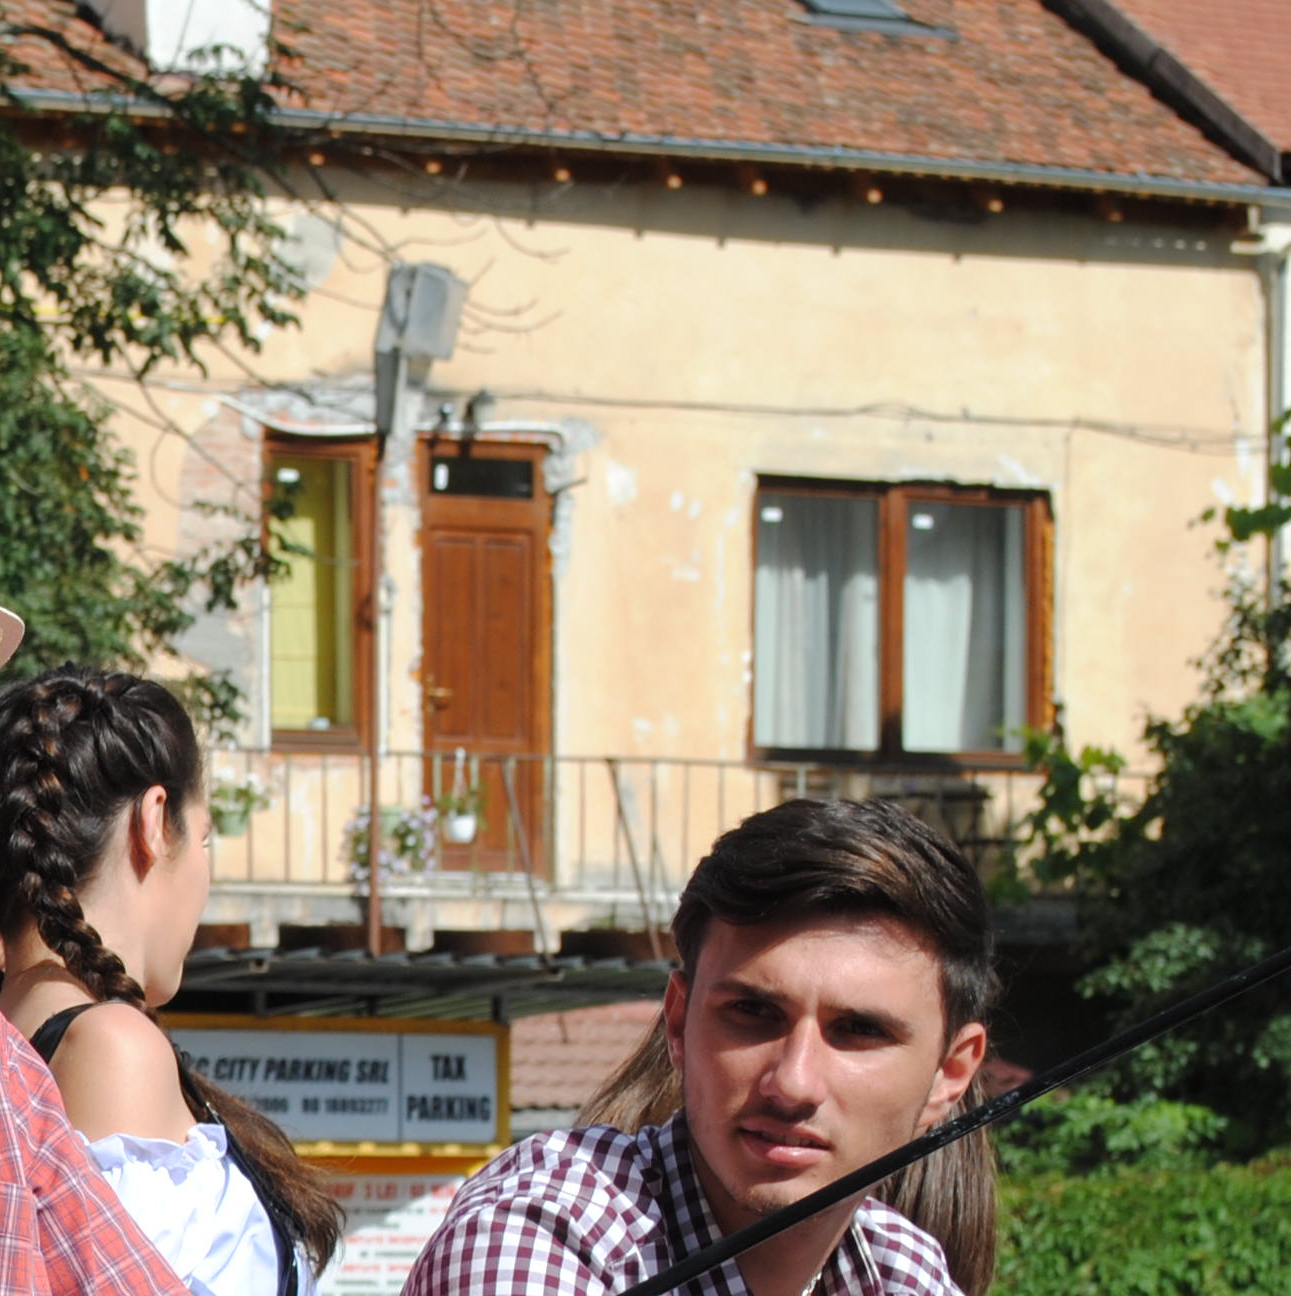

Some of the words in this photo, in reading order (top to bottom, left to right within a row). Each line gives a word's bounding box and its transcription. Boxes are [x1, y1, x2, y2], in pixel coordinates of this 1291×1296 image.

[214, 1057, 260, 1080] CITY
[264, 1058, 351, 1082] PARKING
[355, 1060, 390, 1083] SRL
[429, 1053, 467, 1081] TAX
[407, 1094, 491, 1122] PARKING
